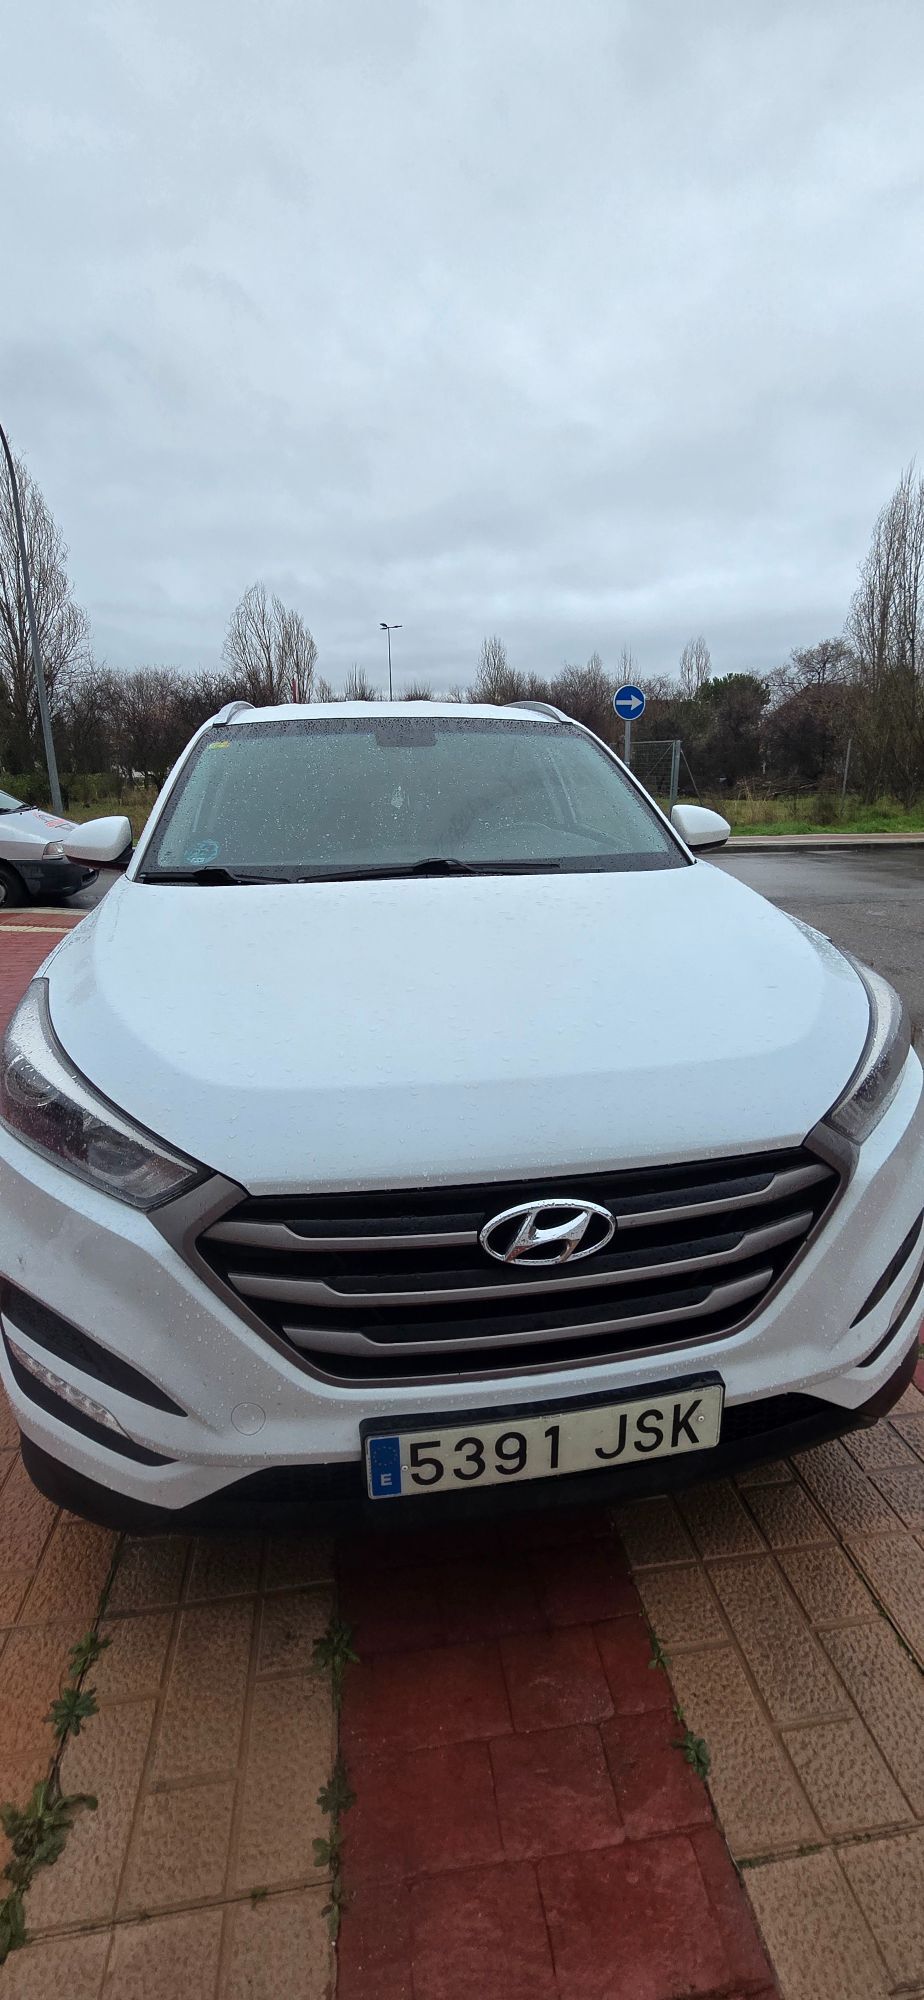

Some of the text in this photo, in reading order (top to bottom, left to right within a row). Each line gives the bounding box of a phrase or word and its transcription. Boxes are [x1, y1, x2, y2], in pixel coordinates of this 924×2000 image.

[409, 1425, 561, 1486] 5391
[594, 1398, 704, 1460] JSK
[380, 1472, 393, 1487] E
